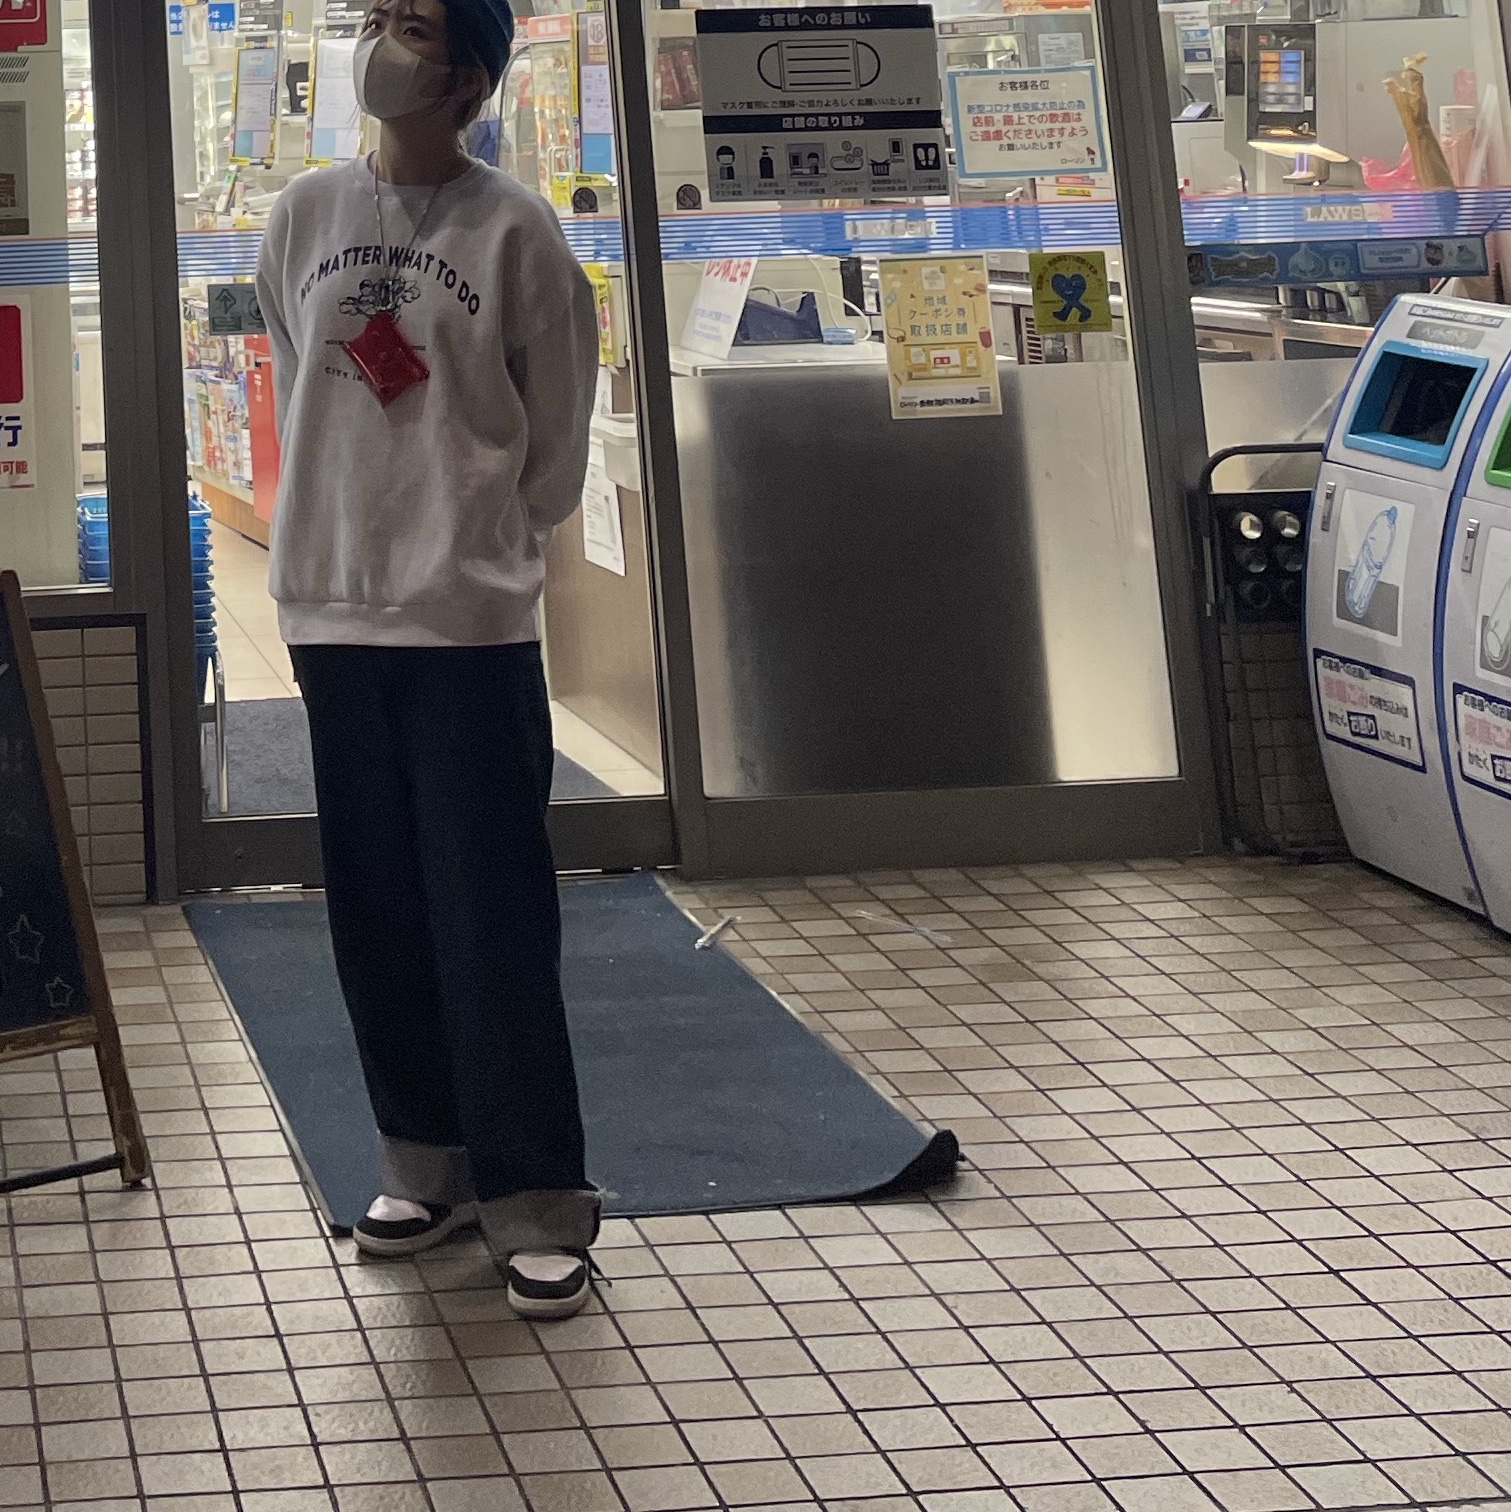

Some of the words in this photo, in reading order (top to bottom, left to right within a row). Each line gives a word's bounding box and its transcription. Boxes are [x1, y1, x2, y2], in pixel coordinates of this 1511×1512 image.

[317, 245, 383, 283] MATTER
[389, 245, 435, 274] WHAT
[436, 259, 457, 290] TO
[457, 280, 481, 316] DO
